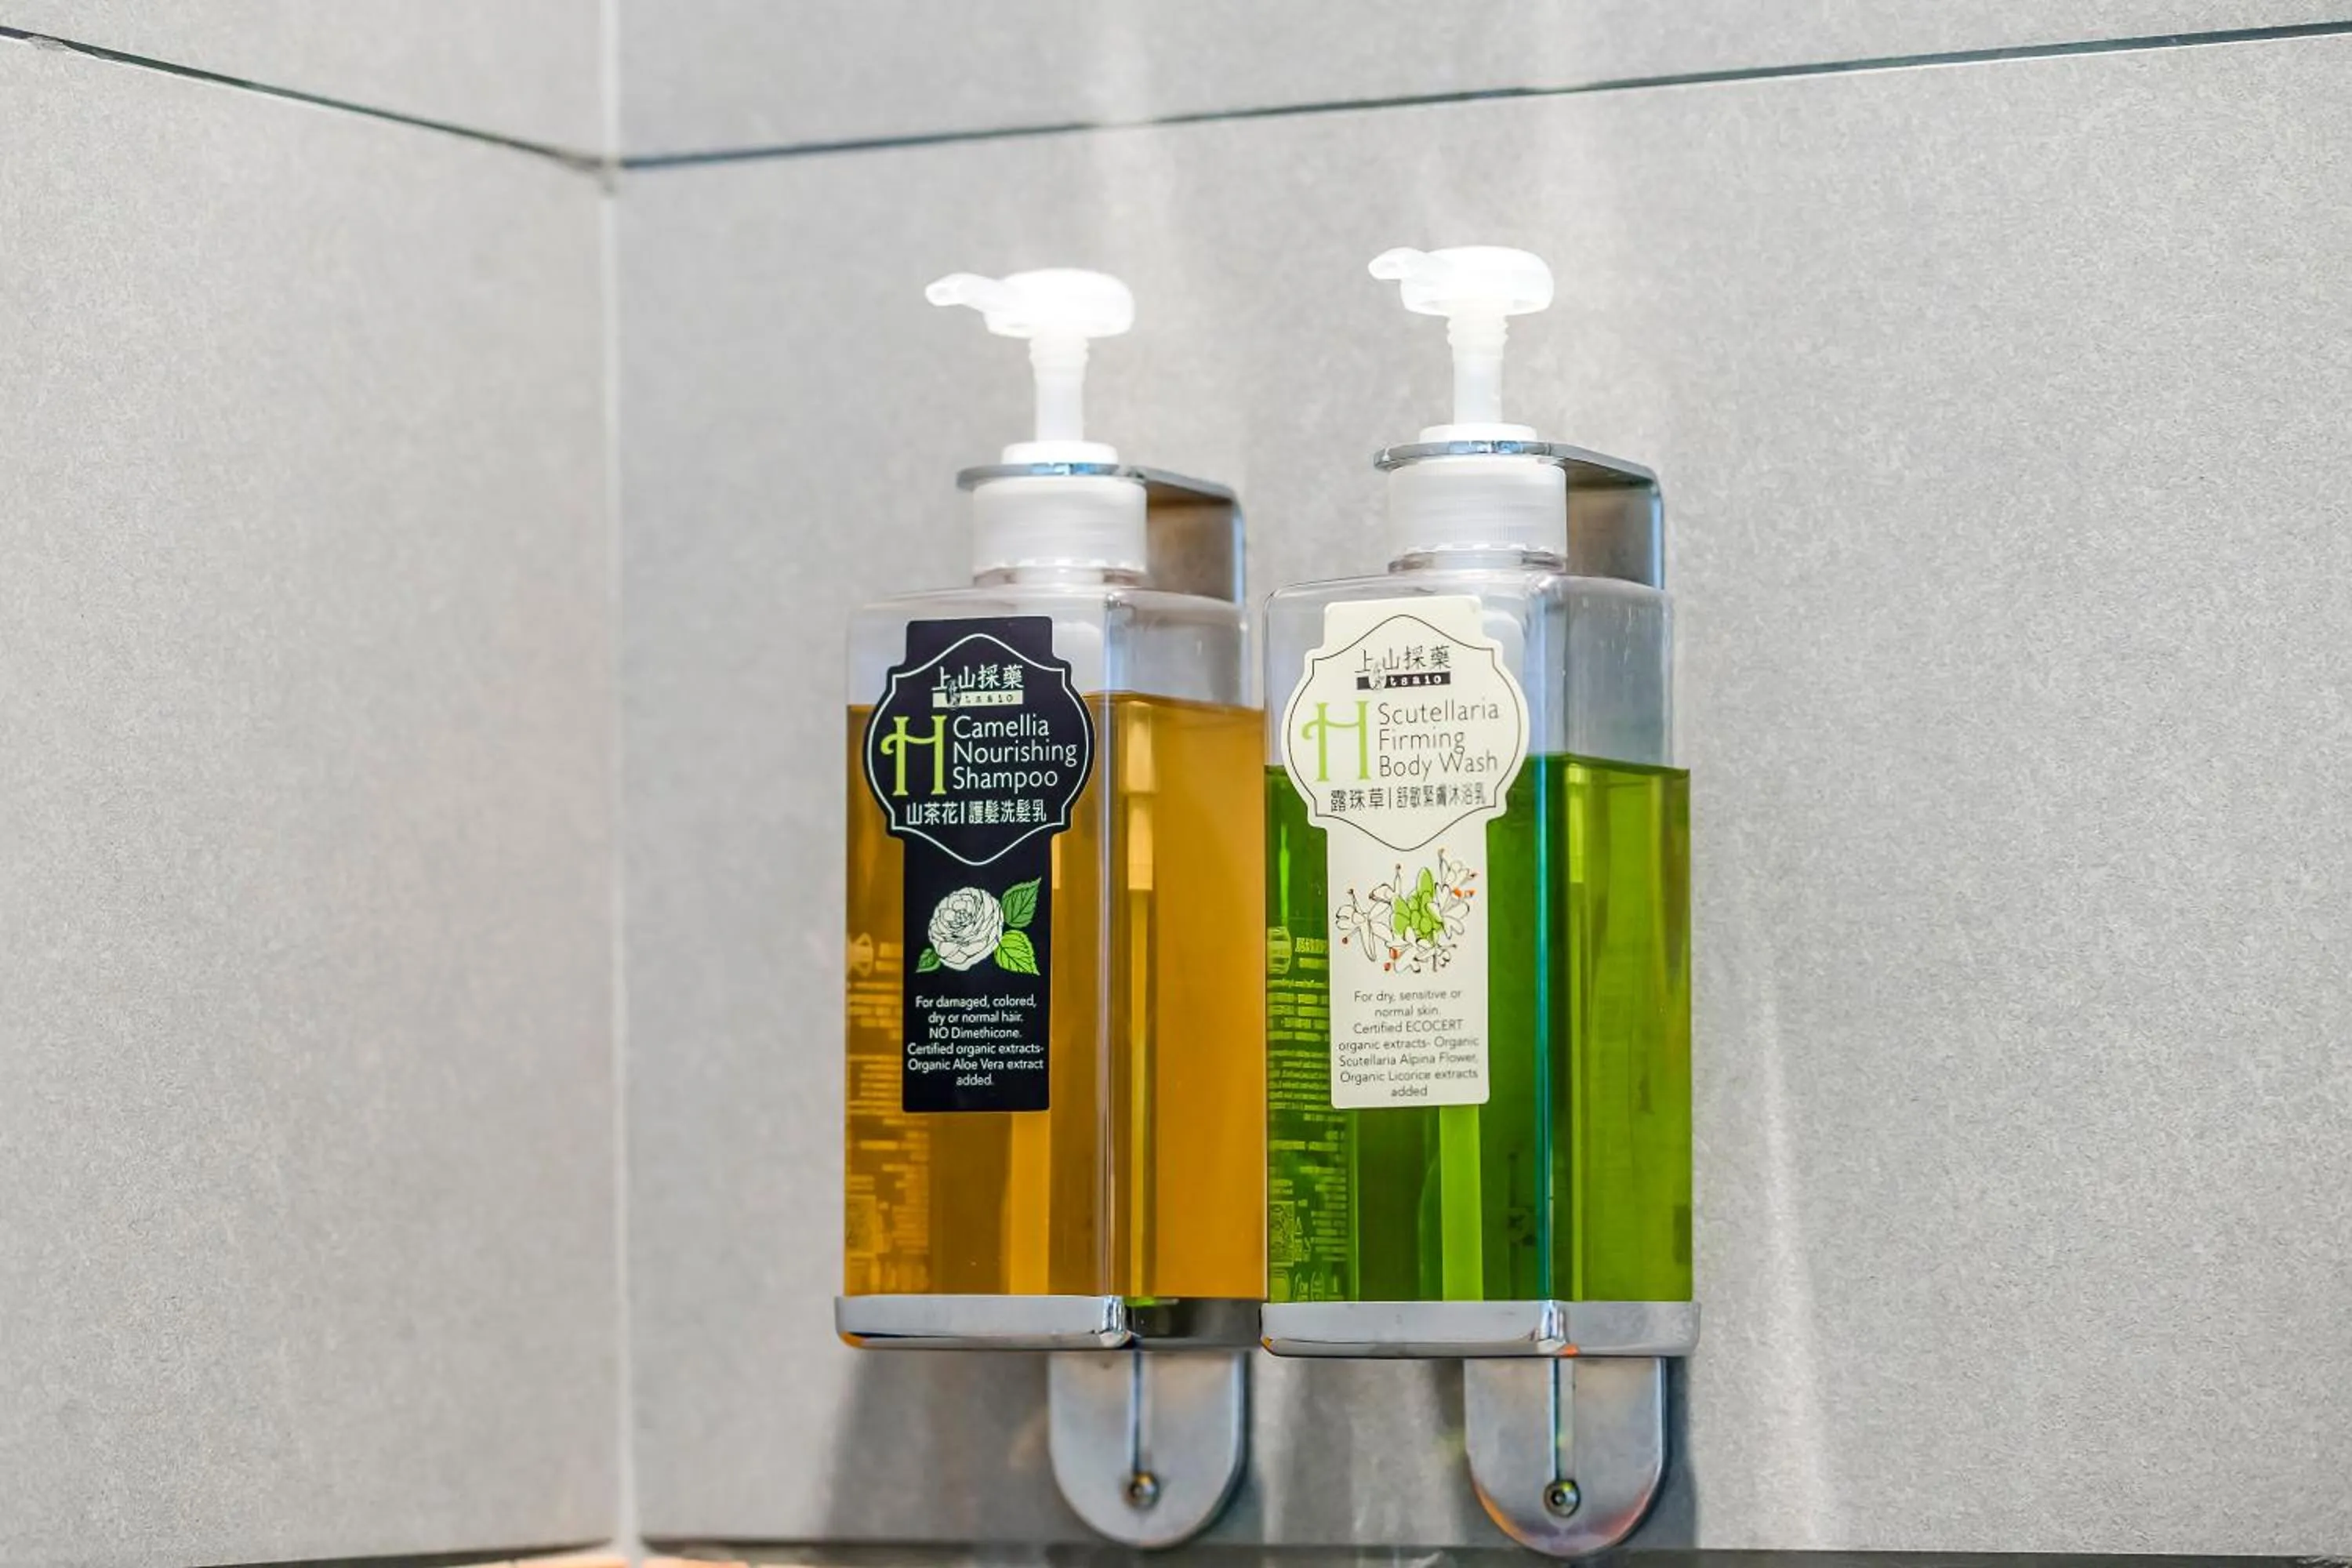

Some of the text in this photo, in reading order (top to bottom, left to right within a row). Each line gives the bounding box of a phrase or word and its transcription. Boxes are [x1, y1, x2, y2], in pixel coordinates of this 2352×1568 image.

[931, 664, 1025, 691] 上山採藥
[1377, 697, 1499, 725] Scutellaria
[953, 713, 1050, 739] Camellia
[1378, 725, 1465, 754] Firming
[953, 739, 1078, 768] Nourishing
[1379, 749, 1498, 782] Body Wash
[953, 766, 1058, 795] Shampoo
[915, 993, 1037, 1011] For damaged, colored,
[1354, 990, 1373, 1003] For
[1399, 989, 1446, 1001] sensitive
[1450, 990, 1461, 999] or
[927, 1011, 946, 1025] dry
[948, 1014, 960, 1023] or
[961, 1010, 1000, 1022] normal
[1374, 1006, 1413, 1017] normal
[929, 1026, 1022, 1039] NO Dimethicone.
[1353, 1019, 1464, 1034] Certified ECOCERT
[907, 1042, 954, 1055] Certified
[956, 1043, 996, 1057] organic
[1338, 1040, 1380, 1054] organic
[1434, 1036, 1479, 1049] Organic
[907, 1058, 1044, 1073] Organic Aloe Vera extract
[1339, 1054, 1396, 1067] Scutellaria
[1340, 1071, 1385, 1085] Organic
[1434, 1069, 1479, 1080] extracts
